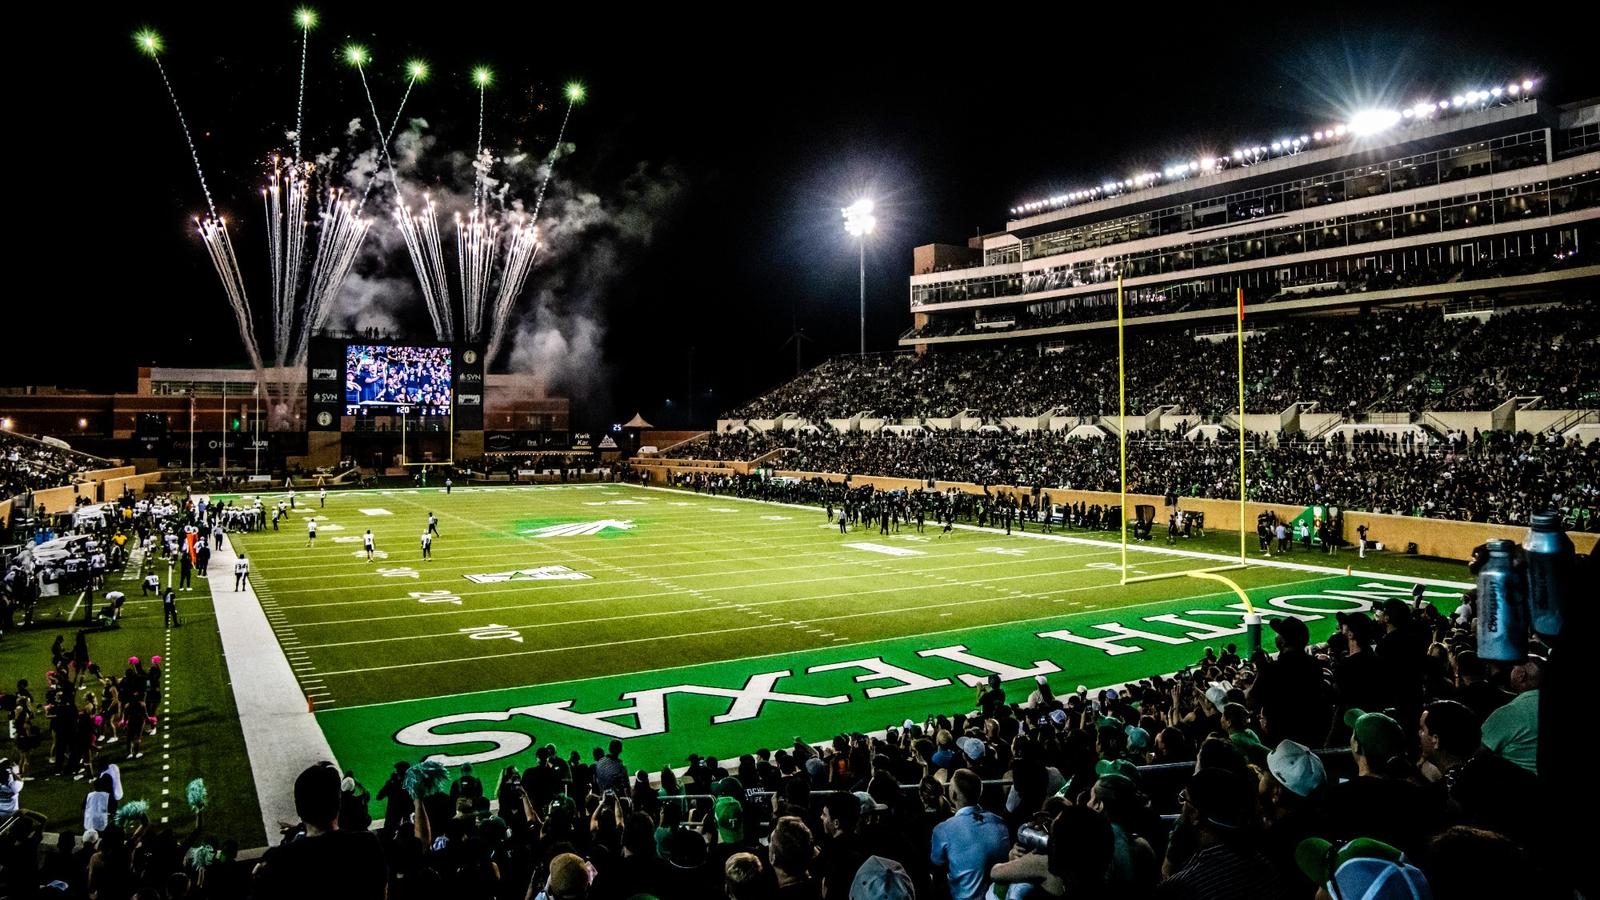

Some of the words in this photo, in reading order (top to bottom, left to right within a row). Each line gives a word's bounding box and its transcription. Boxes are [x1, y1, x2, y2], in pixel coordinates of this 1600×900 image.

[466, 373, 481, 381] SVN
[321, 393, 338, 401] SVN
[613, 423, 622, 431] 25
[408, 590, 461, 604] 20
[459, 623, 520, 641] 10
[391, 643, 1066, 767] TEXAS
